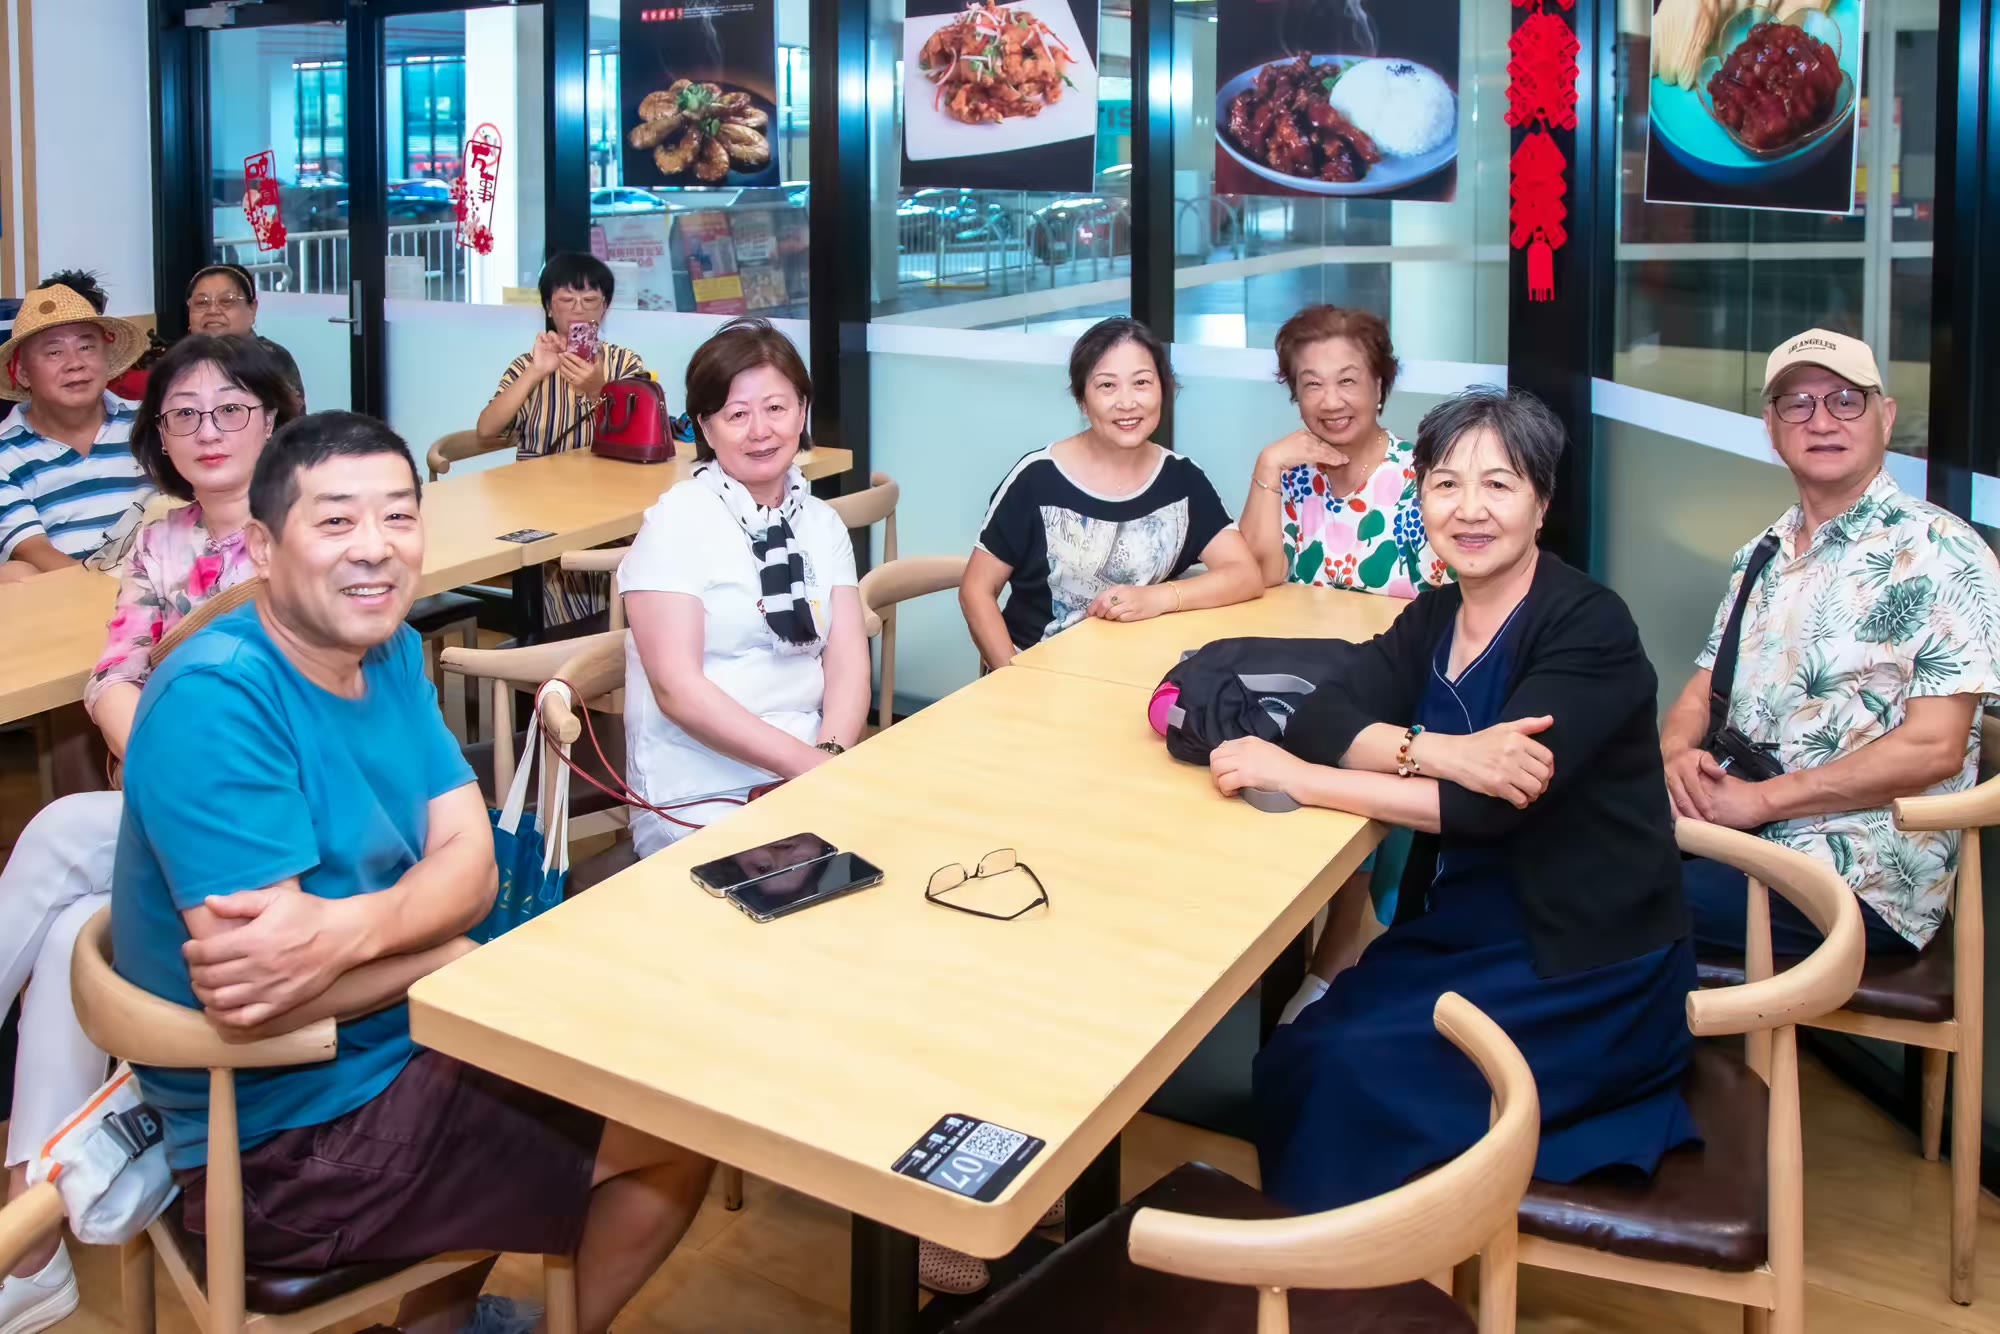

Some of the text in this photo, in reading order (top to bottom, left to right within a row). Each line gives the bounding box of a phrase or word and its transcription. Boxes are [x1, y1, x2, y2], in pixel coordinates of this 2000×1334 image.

[957, 1121, 975, 1137] SCAN
[947, 1135, 959, 1145] ME
[940, 1145, 951, 1154] TO
[919, 1153, 942, 1173] ORDER
[940, 1156, 983, 1190] 07
